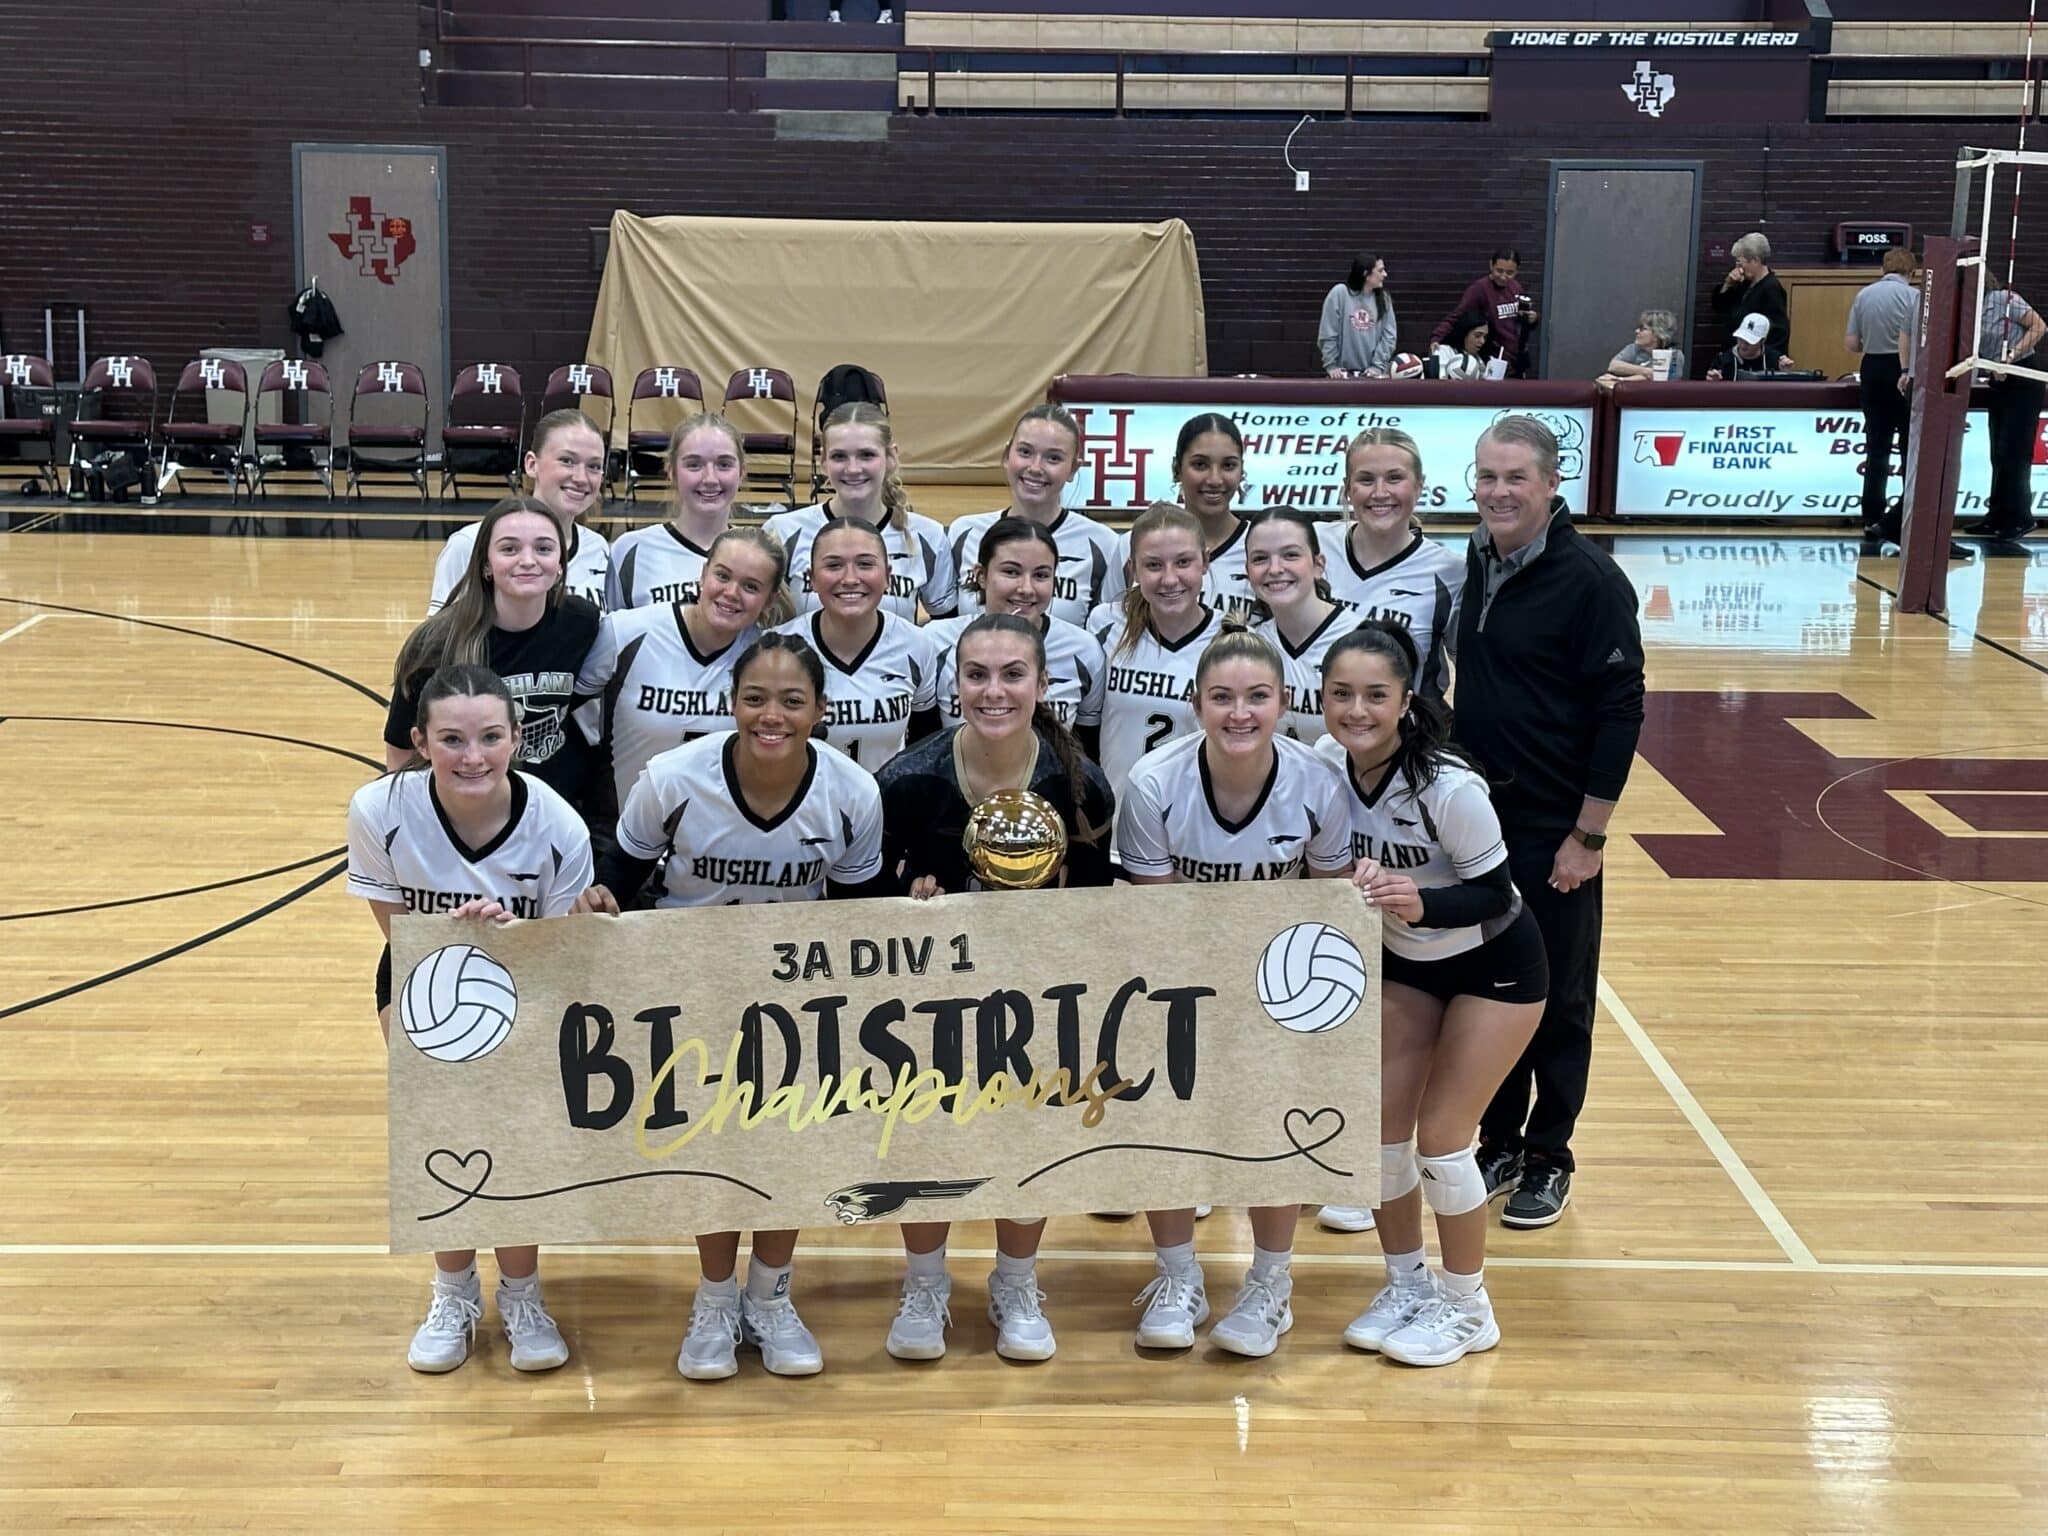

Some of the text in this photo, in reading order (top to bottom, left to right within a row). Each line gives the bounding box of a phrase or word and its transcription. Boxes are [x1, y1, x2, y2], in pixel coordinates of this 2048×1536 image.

[1510, 32, 1799, 45] HOME OF THE HOSTILE HERD
[1858, 233, 1890, 244] POSS.
[1231, 411, 1401, 427] Home of the
[1713, 424, 1776, 439] FIRST
[1688, 441, 1798, 454] FINANCIAL
[1287, 462, 1338, 476] and
[1712, 456, 1772, 470] BANK
[1664, 488, 1795, 512] Proudly
[637, 685, 734, 717] BUSHLA
[821, 694, 911, 727] SHLAND
[1143, 711, 1176, 754] 2
[692, 856, 824, 888] BUSHLAND
[771, 932, 975, 981] 3A DIV 1
[558, 976, 1217, 1131] BI-DISTRICT
[633, 1030, 1135, 1160] Champions
